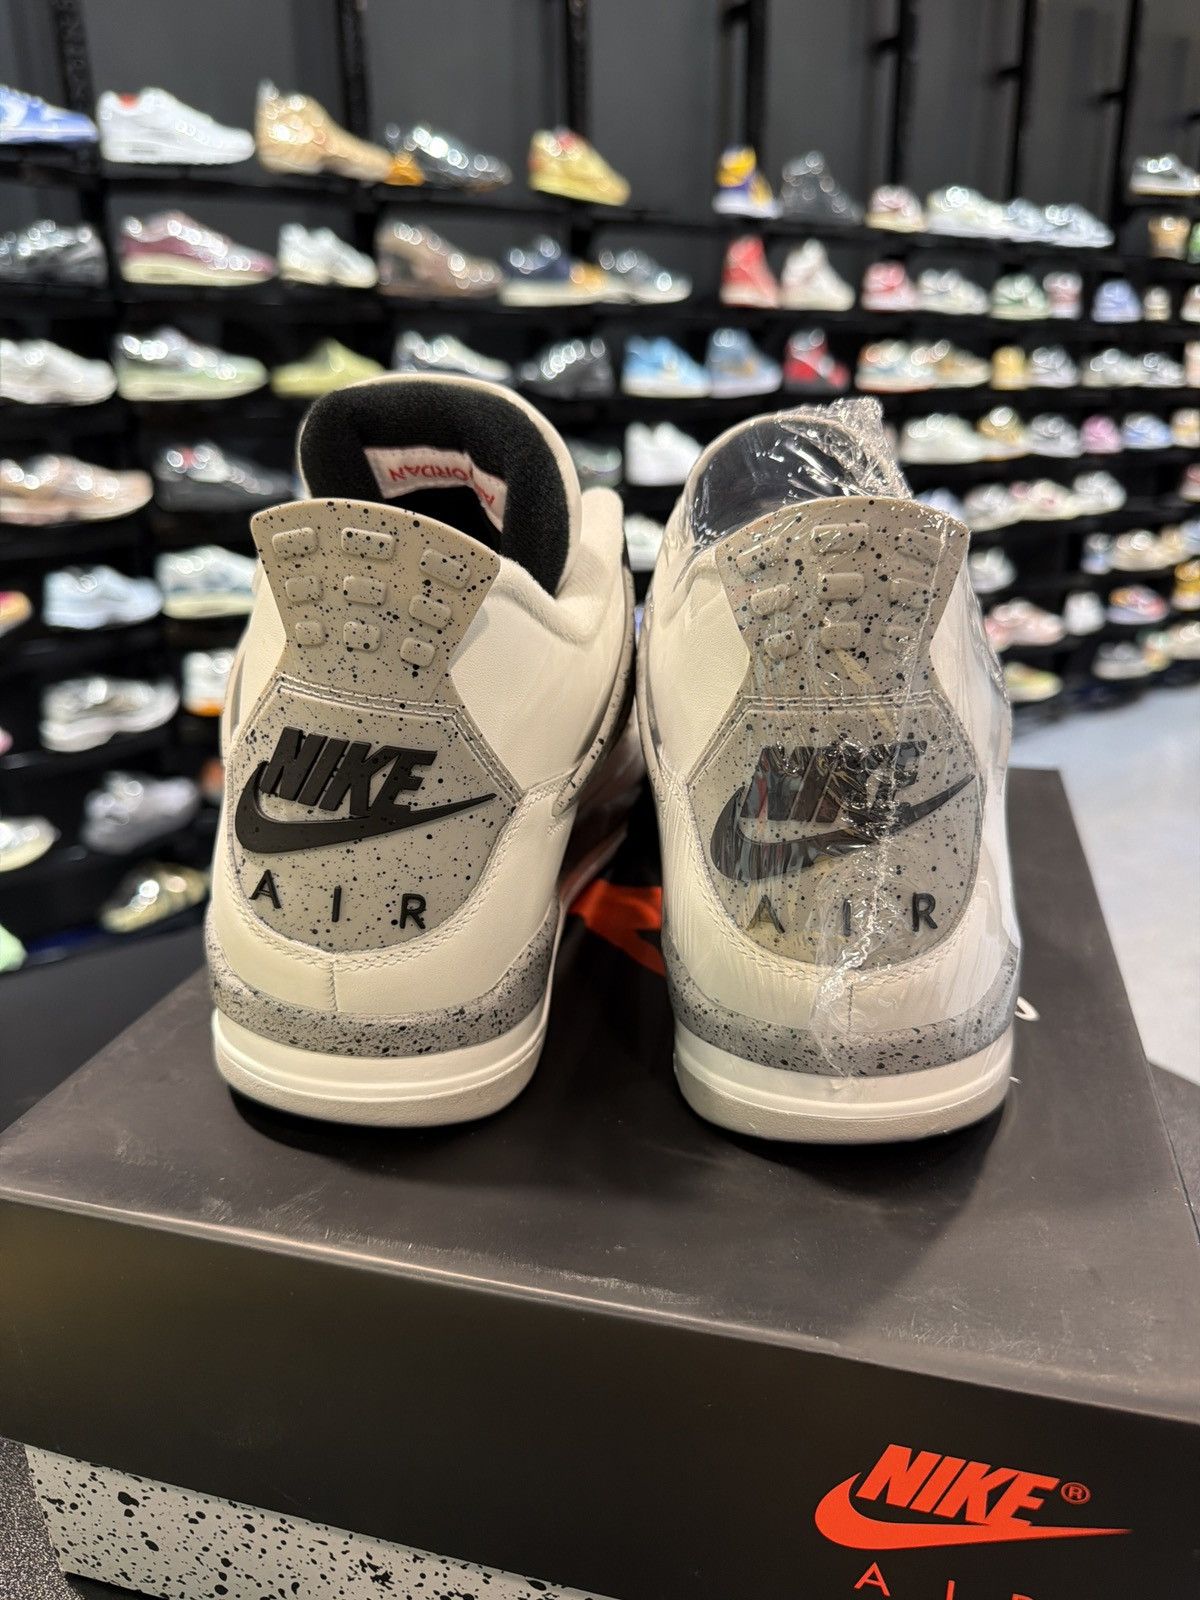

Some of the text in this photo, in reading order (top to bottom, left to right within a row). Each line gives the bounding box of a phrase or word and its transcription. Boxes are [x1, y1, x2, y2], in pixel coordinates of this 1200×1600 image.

[259, 726, 437, 817] NIKE
[740, 740, 928, 826] NIKE
[250, 869, 426, 929] AIR
[745, 891, 938, 937] AIR
[856, 1444, 1060, 1527] NIKE
[854, 1562, 1039, 1600] AI
